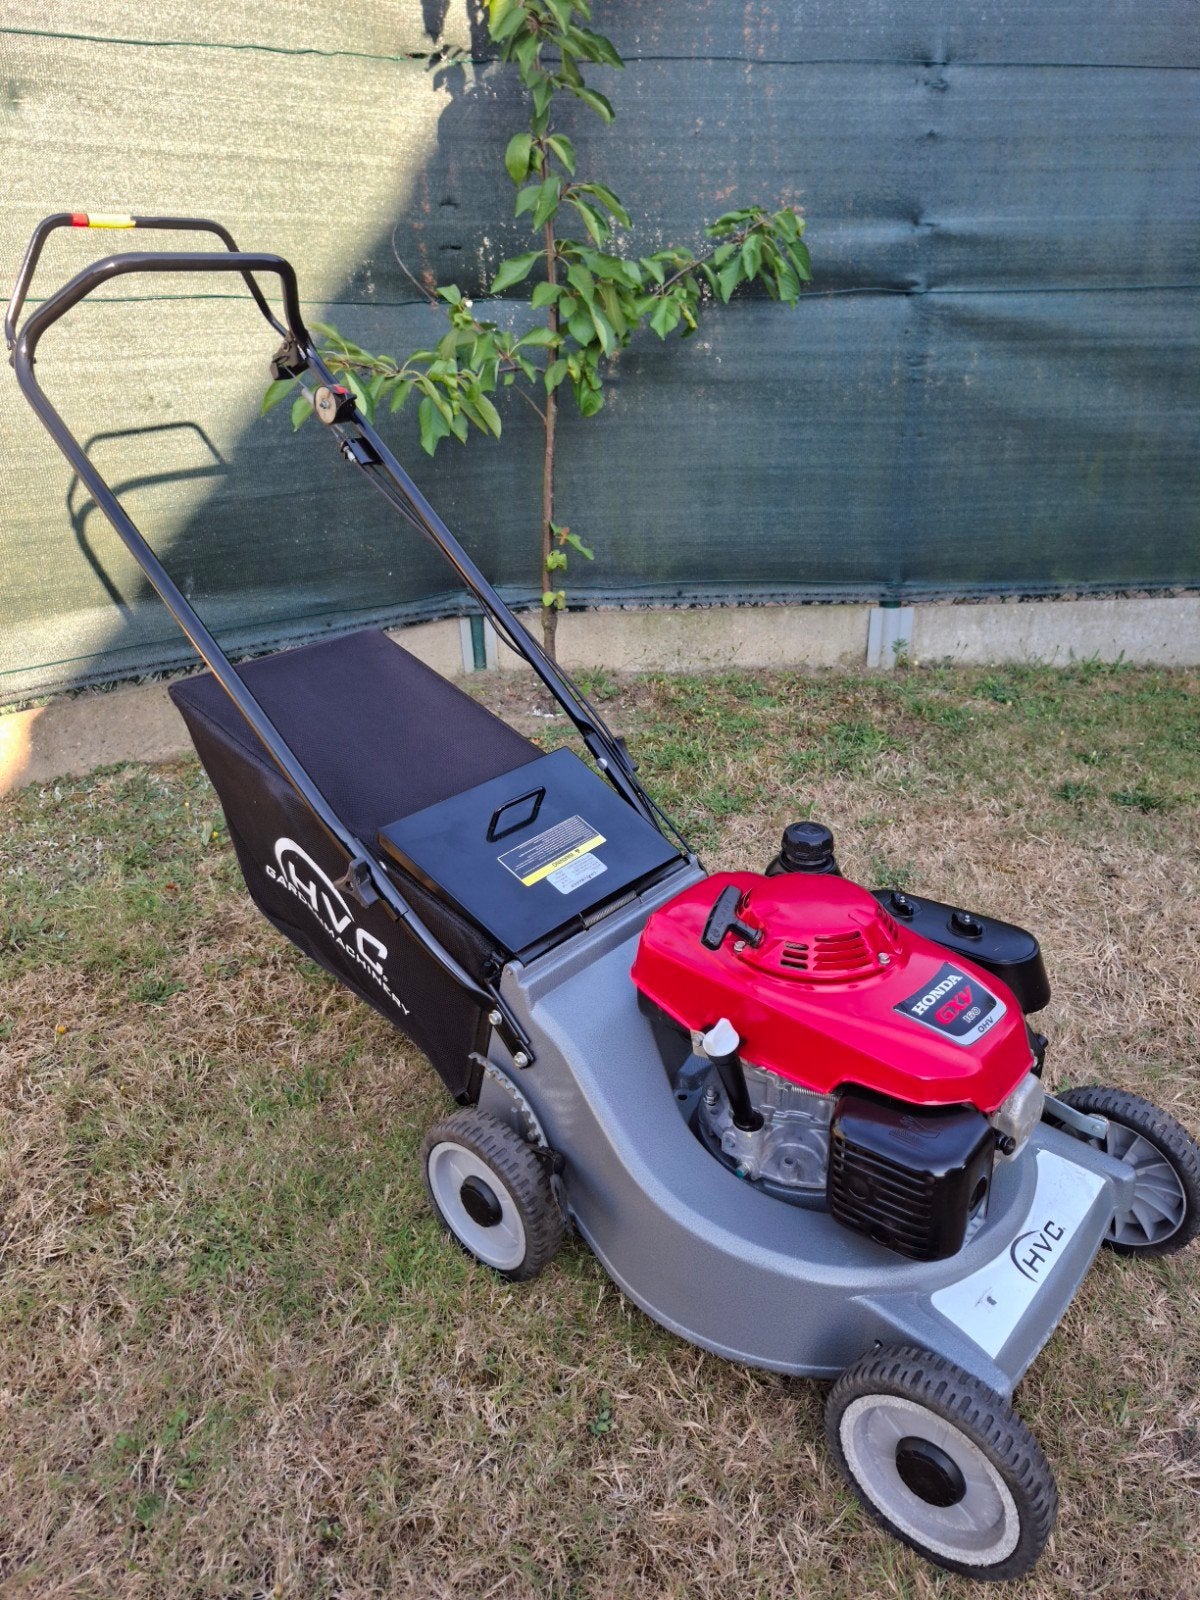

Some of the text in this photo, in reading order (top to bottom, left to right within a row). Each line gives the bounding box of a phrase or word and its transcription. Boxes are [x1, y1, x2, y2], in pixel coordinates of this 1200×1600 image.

[288, 861, 388, 976] HVC
[324, 922, 410, 1016] MACHINERY
[911, 974, 964, 1016] HONDA
[934, 985, 973, 1025] GXV
[962, 1006, 981, 1023] 160
[977, 1016, 994, 1033] OHV
[1022, 1220, 1065, 1274] HVC
